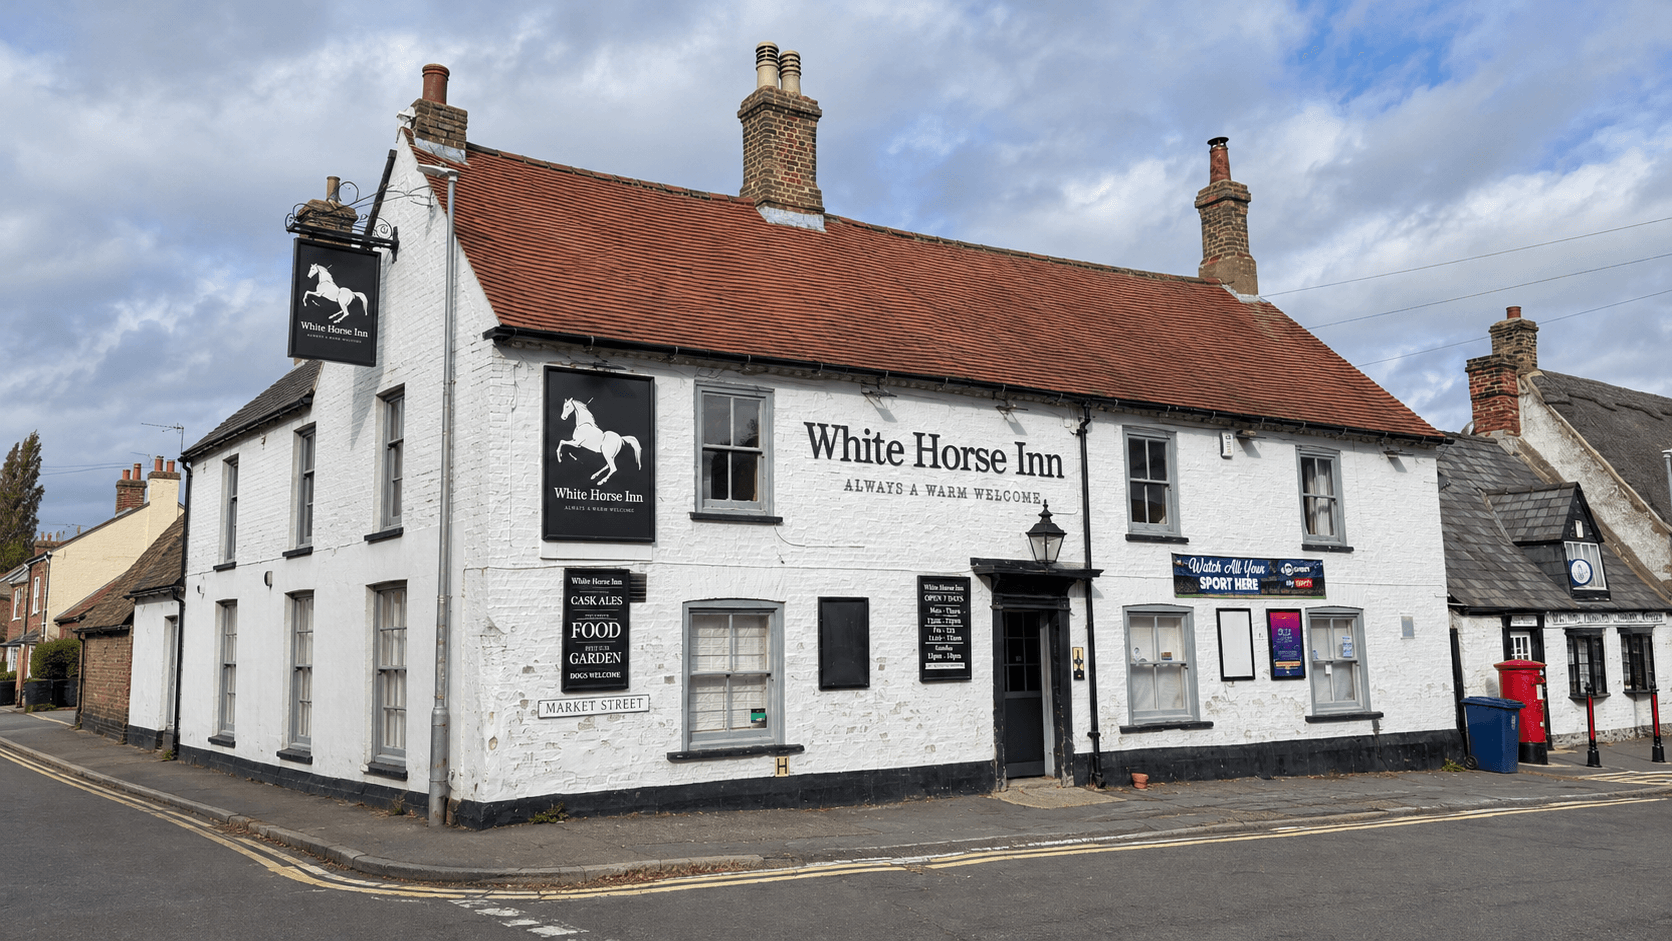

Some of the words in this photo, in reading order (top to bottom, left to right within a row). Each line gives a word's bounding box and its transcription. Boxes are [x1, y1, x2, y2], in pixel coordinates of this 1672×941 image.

[301, 321, 326, 332] White
[328, 325, 352, 336] Horse
[354, 328, 368, 338] Inn
[804, 422, 904, 466] White
[913, 432, 1007, 474] Horse
[1014, 442, 1064, 478] Inn
[554, 488, 588, 500] White
[590, 489, 622, 502] Horse
[624, 490, 644, 502] Inn
[844, 478, 903, 496] ALWAYS
[910, 485, 918, 496] A
[926, 484, 968, 499] WARM
[974, 488, 1041, 504] WELCOME
[1188, 558, 1221, 574] Watch
[1224, 559, 1242, 574] All
[1244, 560, 1265, 580] Your
[1200, 576, 1232, 590] SPORT
[1234, 578, 1258, 590] HERE
[570, 596, 596, 606] CASK
[598, 596, 622, 606] ALES
[571, 622, 621, 638] FOOD
[570, 652, 622, 664] GARDEN
[546, 700, 596, 714] MARKET
[601, 698, 644, 710] STREET
[776, 758, 788, 775] H
